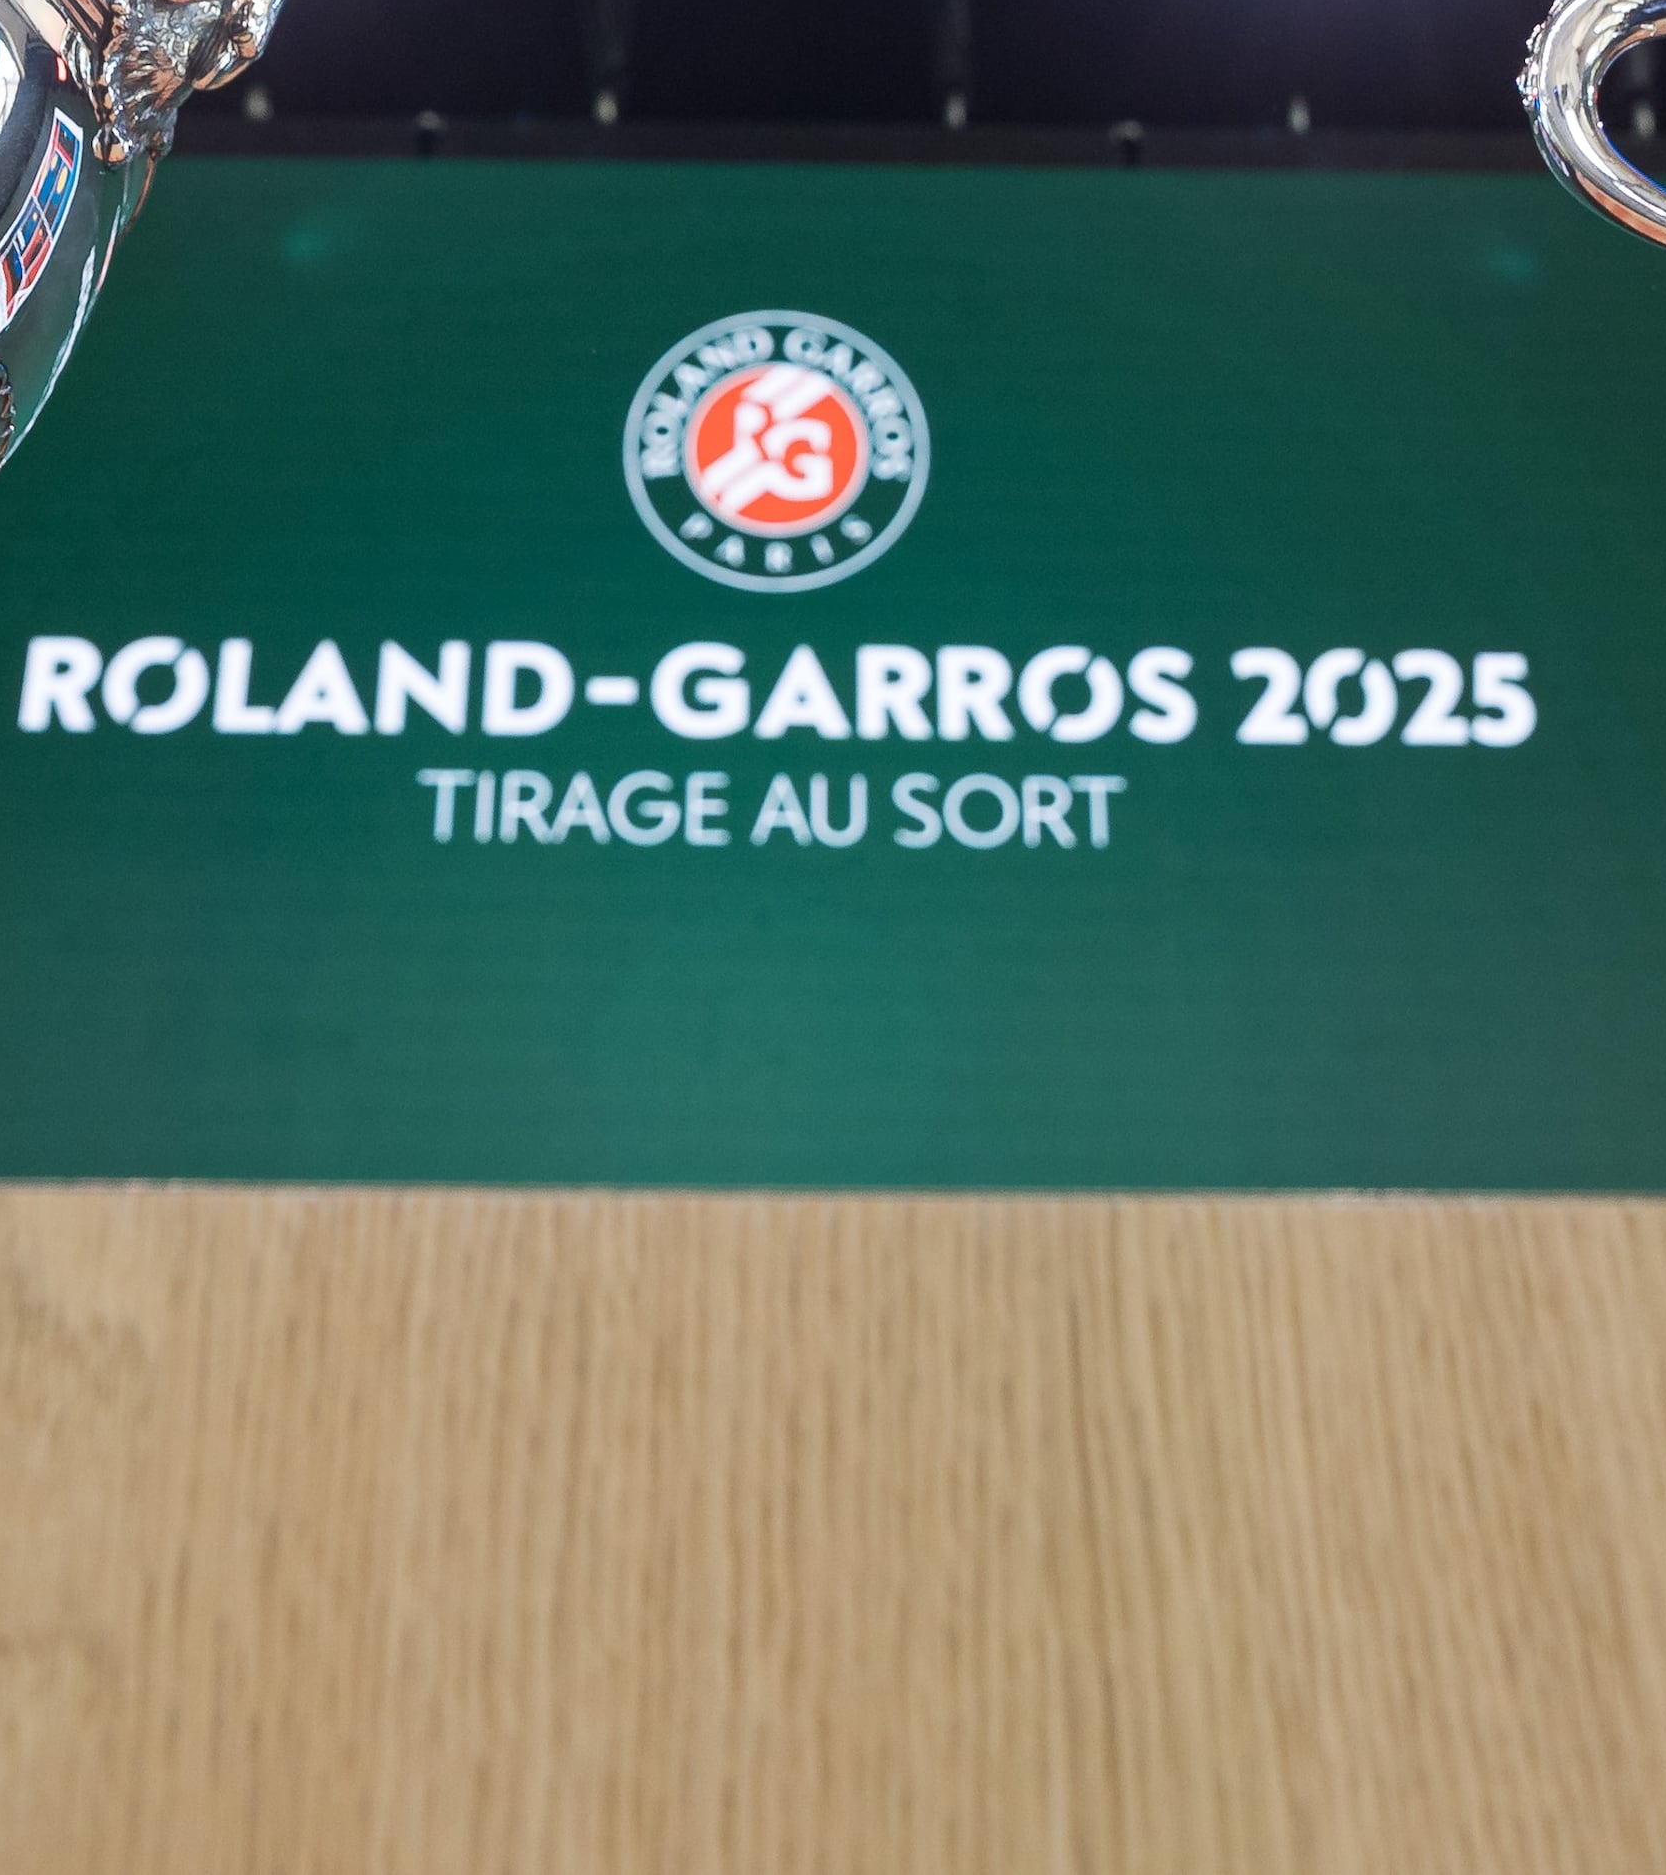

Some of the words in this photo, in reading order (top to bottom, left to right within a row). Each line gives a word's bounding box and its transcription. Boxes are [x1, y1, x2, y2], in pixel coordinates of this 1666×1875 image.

[640, 325, 775, 481] ROLAND
[784, 325, 913, 483] GARROS
[679, 512, 874, 574] PARIS
[17, 635, 1199, 745] ROLAND-GARROS
[1230, 646, 1537, 749] 2025
[415, 768, 732, 847] TIRAGE
[748, 770, 869, 849] AU
[890, 771, 1129, 851] SORT
